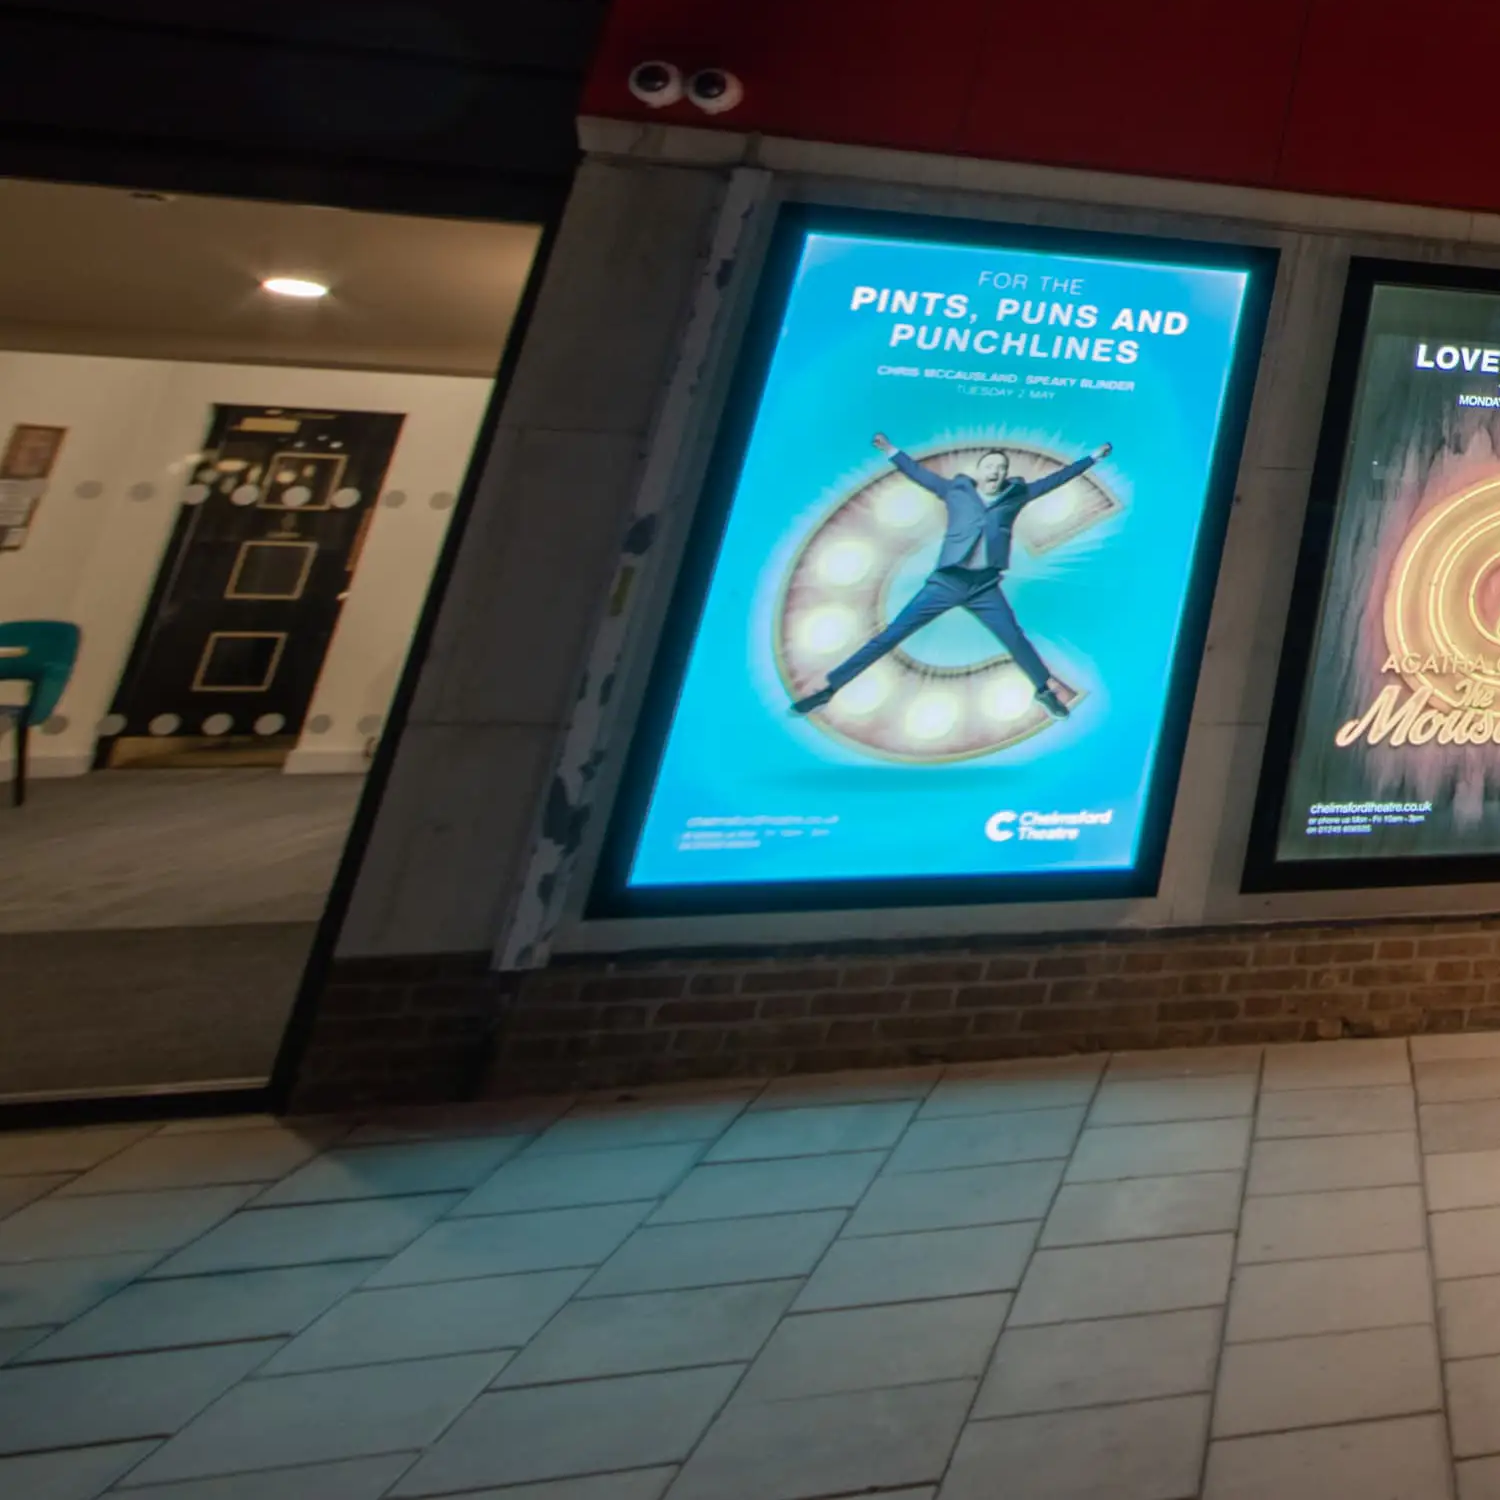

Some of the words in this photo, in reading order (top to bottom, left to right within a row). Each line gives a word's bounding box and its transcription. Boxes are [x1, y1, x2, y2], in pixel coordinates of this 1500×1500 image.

[977, 270, 1028, 291] FOR
[1040, 276, 1085, 296] THE
[850, 286, 978, 324] PINTS,
[996, 298, 1099, 329] PUNS
[1111, 308, 1190, 336] AND
[889, 323, 1140, 365] PUNCHLINES
[877, 365, 920, 378] CHRIS
[1416, 344, 1500, 373] LOVE
[1381, 653, 1487, 674] AGATHA
[1452, 680, 1495, 708] The
